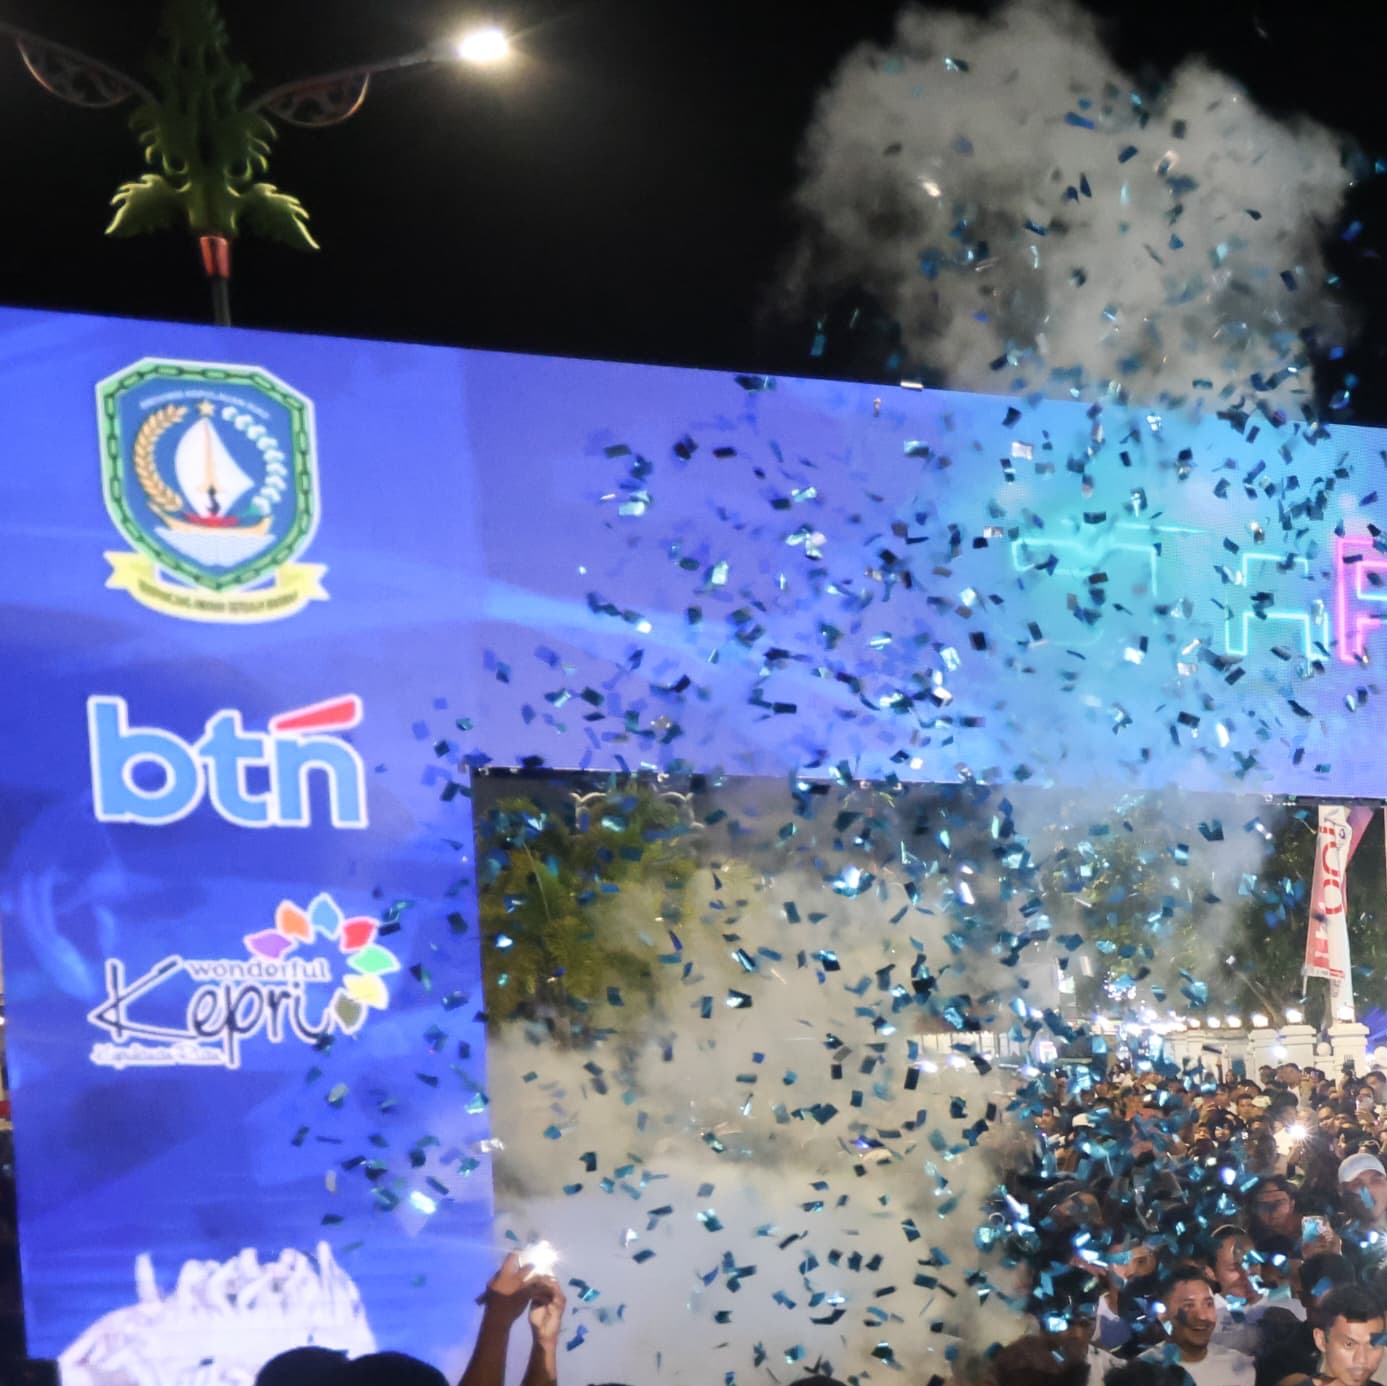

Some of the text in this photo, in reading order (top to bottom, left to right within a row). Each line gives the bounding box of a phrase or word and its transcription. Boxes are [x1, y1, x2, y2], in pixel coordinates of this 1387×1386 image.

[88, 694, 367, 828] btn
[88, 955, 330, 1068] Kepri
[187, 959, 328, 980] wonderful
